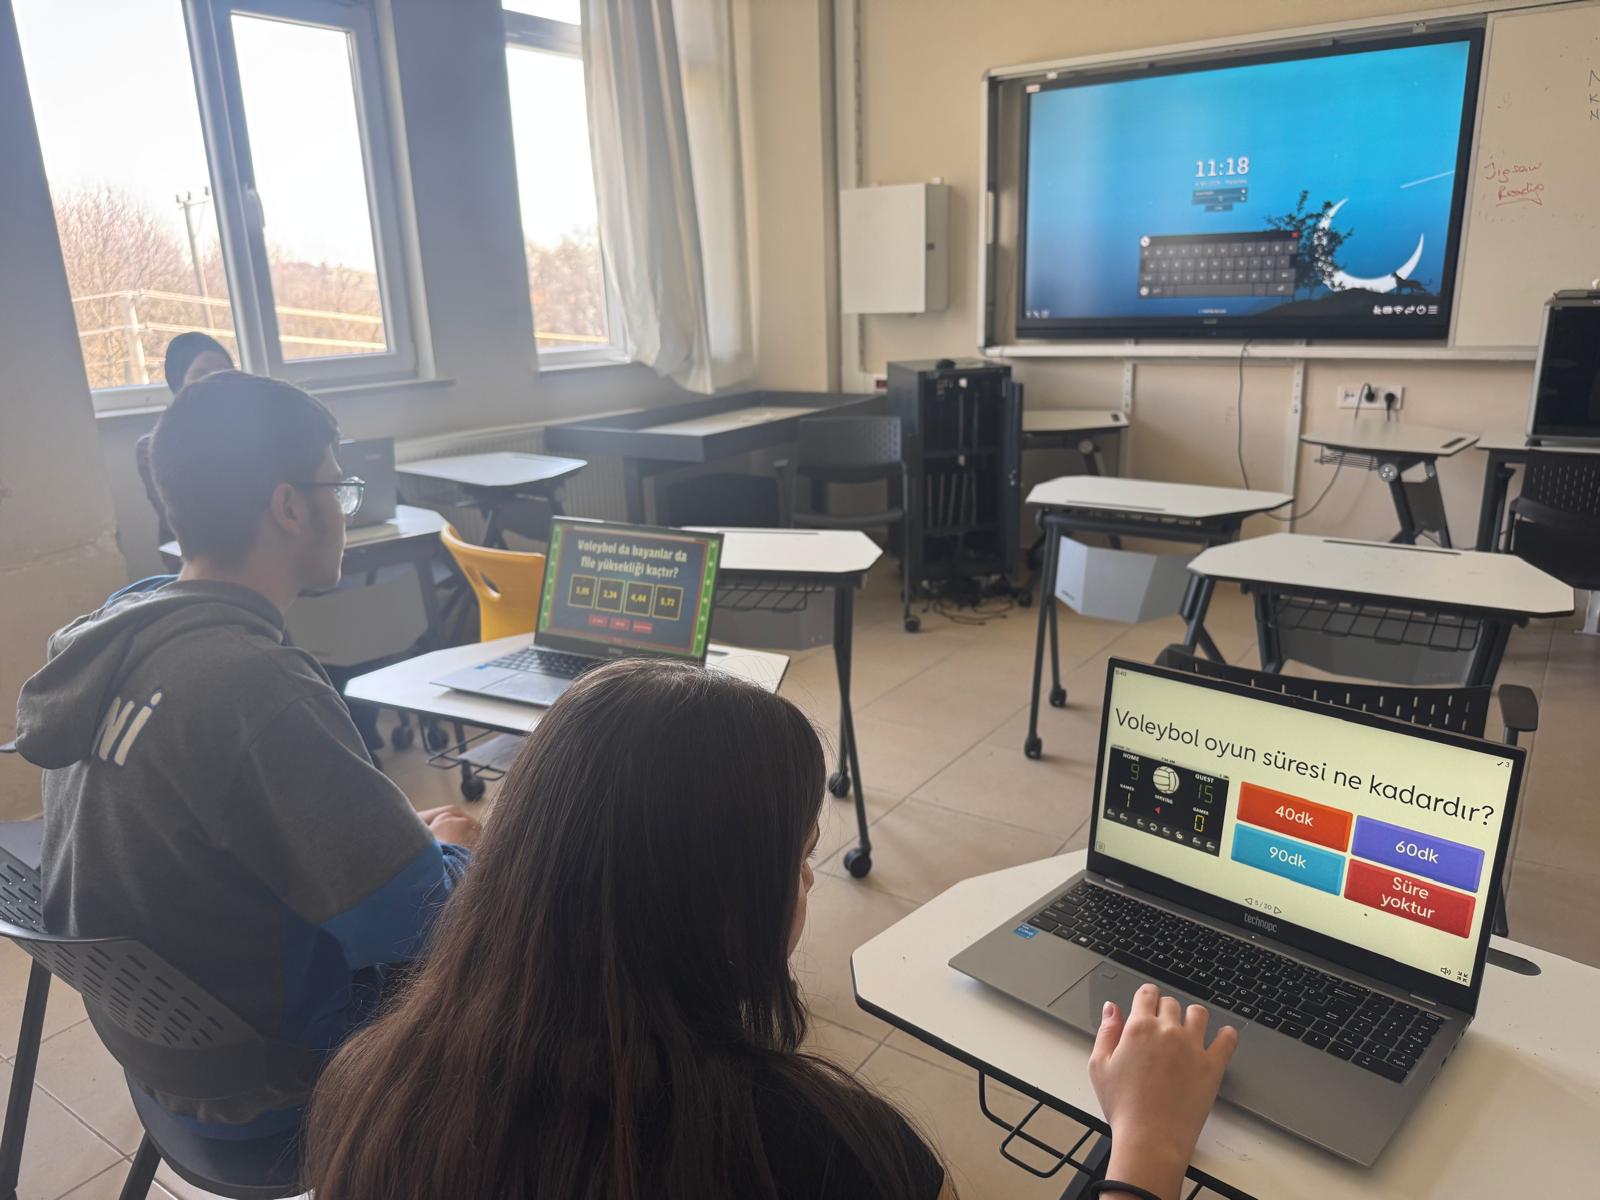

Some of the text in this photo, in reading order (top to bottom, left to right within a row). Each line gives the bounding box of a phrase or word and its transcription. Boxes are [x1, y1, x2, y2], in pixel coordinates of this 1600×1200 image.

[1195, 156, 1249, 177] 11:18
[578, 539, 688, 563] Voleybol da bayanlar da
[1116, 707, 1494, 826] Voleybol oyun süresi ne kadardır?
[1122, 752, 1140, 762] HOME
[1194, 773, 1214, 784] GUEST
[1192, 806, 1209, 816] GAMES
[1275, 805, 1313, 827] 40dk
[1269, 846, 1306, 869] 90dk
[1395, 840, 1439, 864] 60dk
[1392, 876, 1429, 900] Süre
[1380, 893, 1436, 919] yoktur
[1244, 912, 1278, 933] technopc
